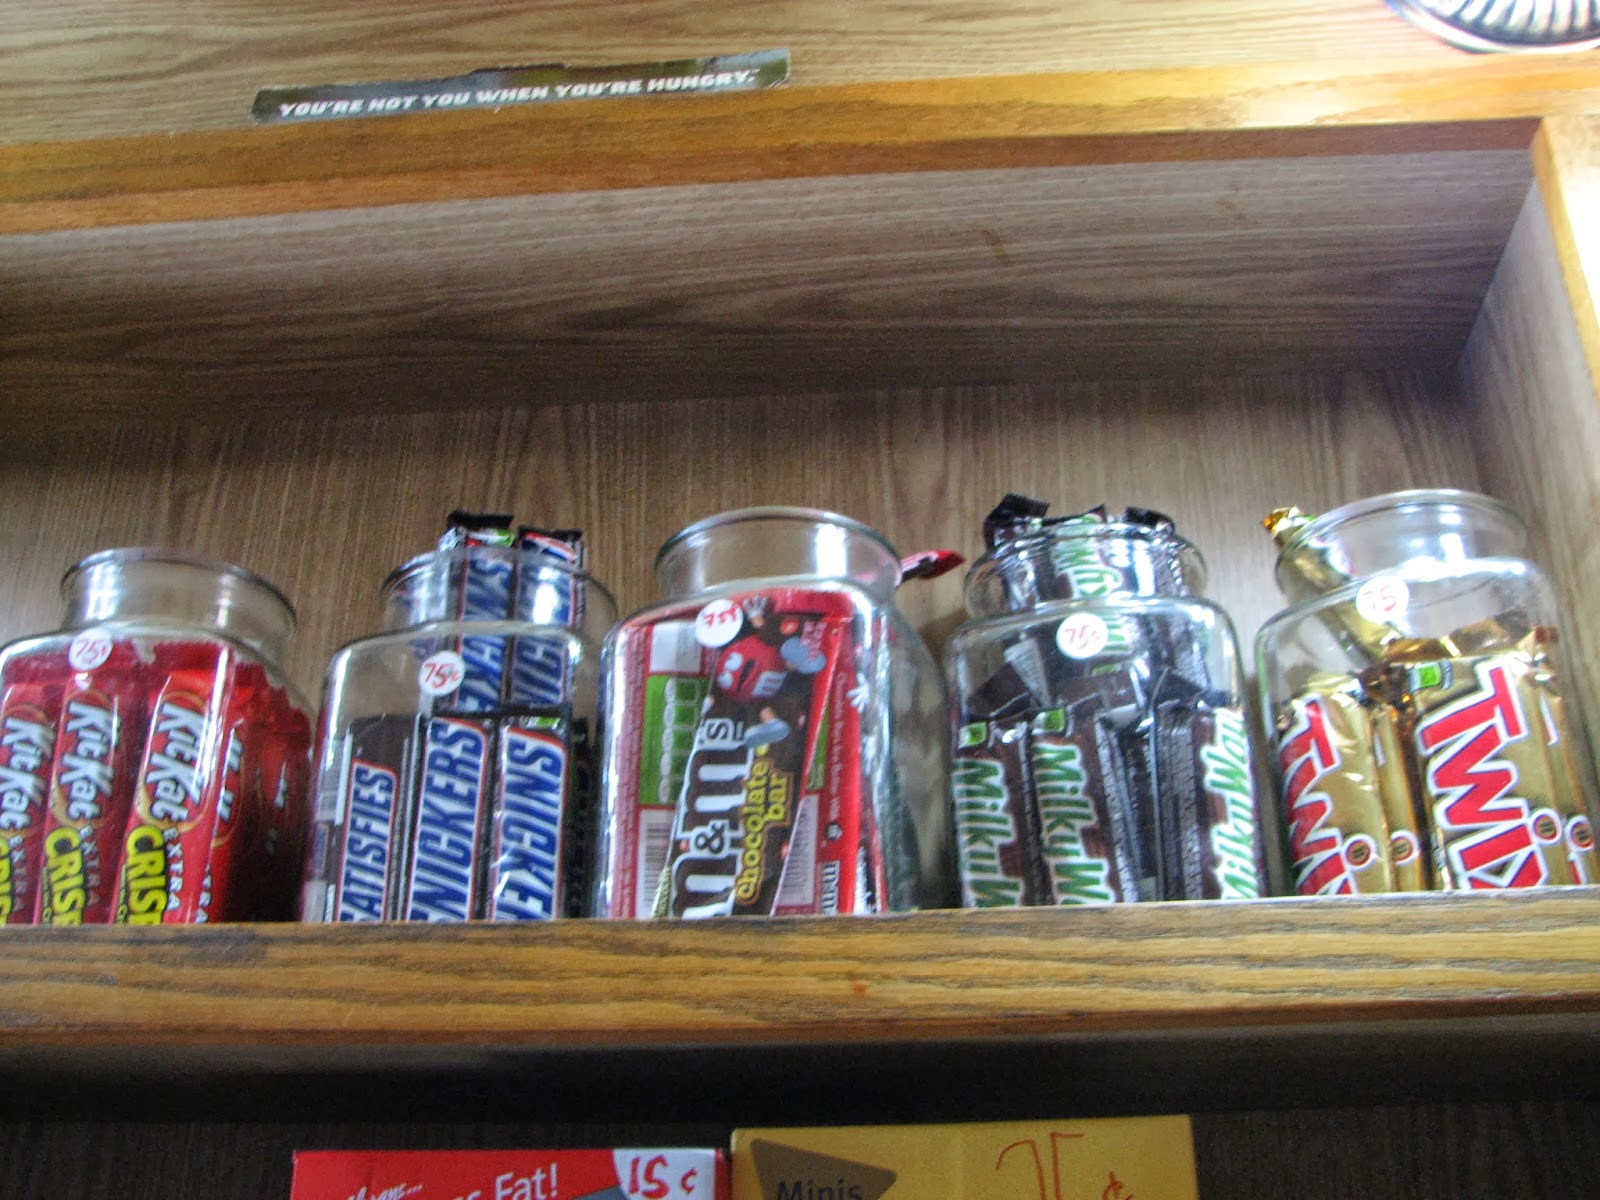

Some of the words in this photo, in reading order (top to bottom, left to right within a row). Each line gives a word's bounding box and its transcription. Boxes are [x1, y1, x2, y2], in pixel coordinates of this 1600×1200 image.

[279, 99, 366, 118] YOU'RE
[367, 95, 419, 112] NOT
[422, 91, 472, 109] YOU
[475, 85, 550, 102] WHEN
[554, 79, 644, 98] YOU'RE
[494, 734, 563, 921] SNICKE
[735, 759, 770, 899] chocolate
[764, 771, 788, 821] bar
[1278, 696, 1374, 895] TWI
[79, 825, 100, 907] EXTRA
[163, 827, 184, 911] EXTRA
[495, 1162, 558, 1200] Fat!
[777, 1179, 863, 1200] Minis
